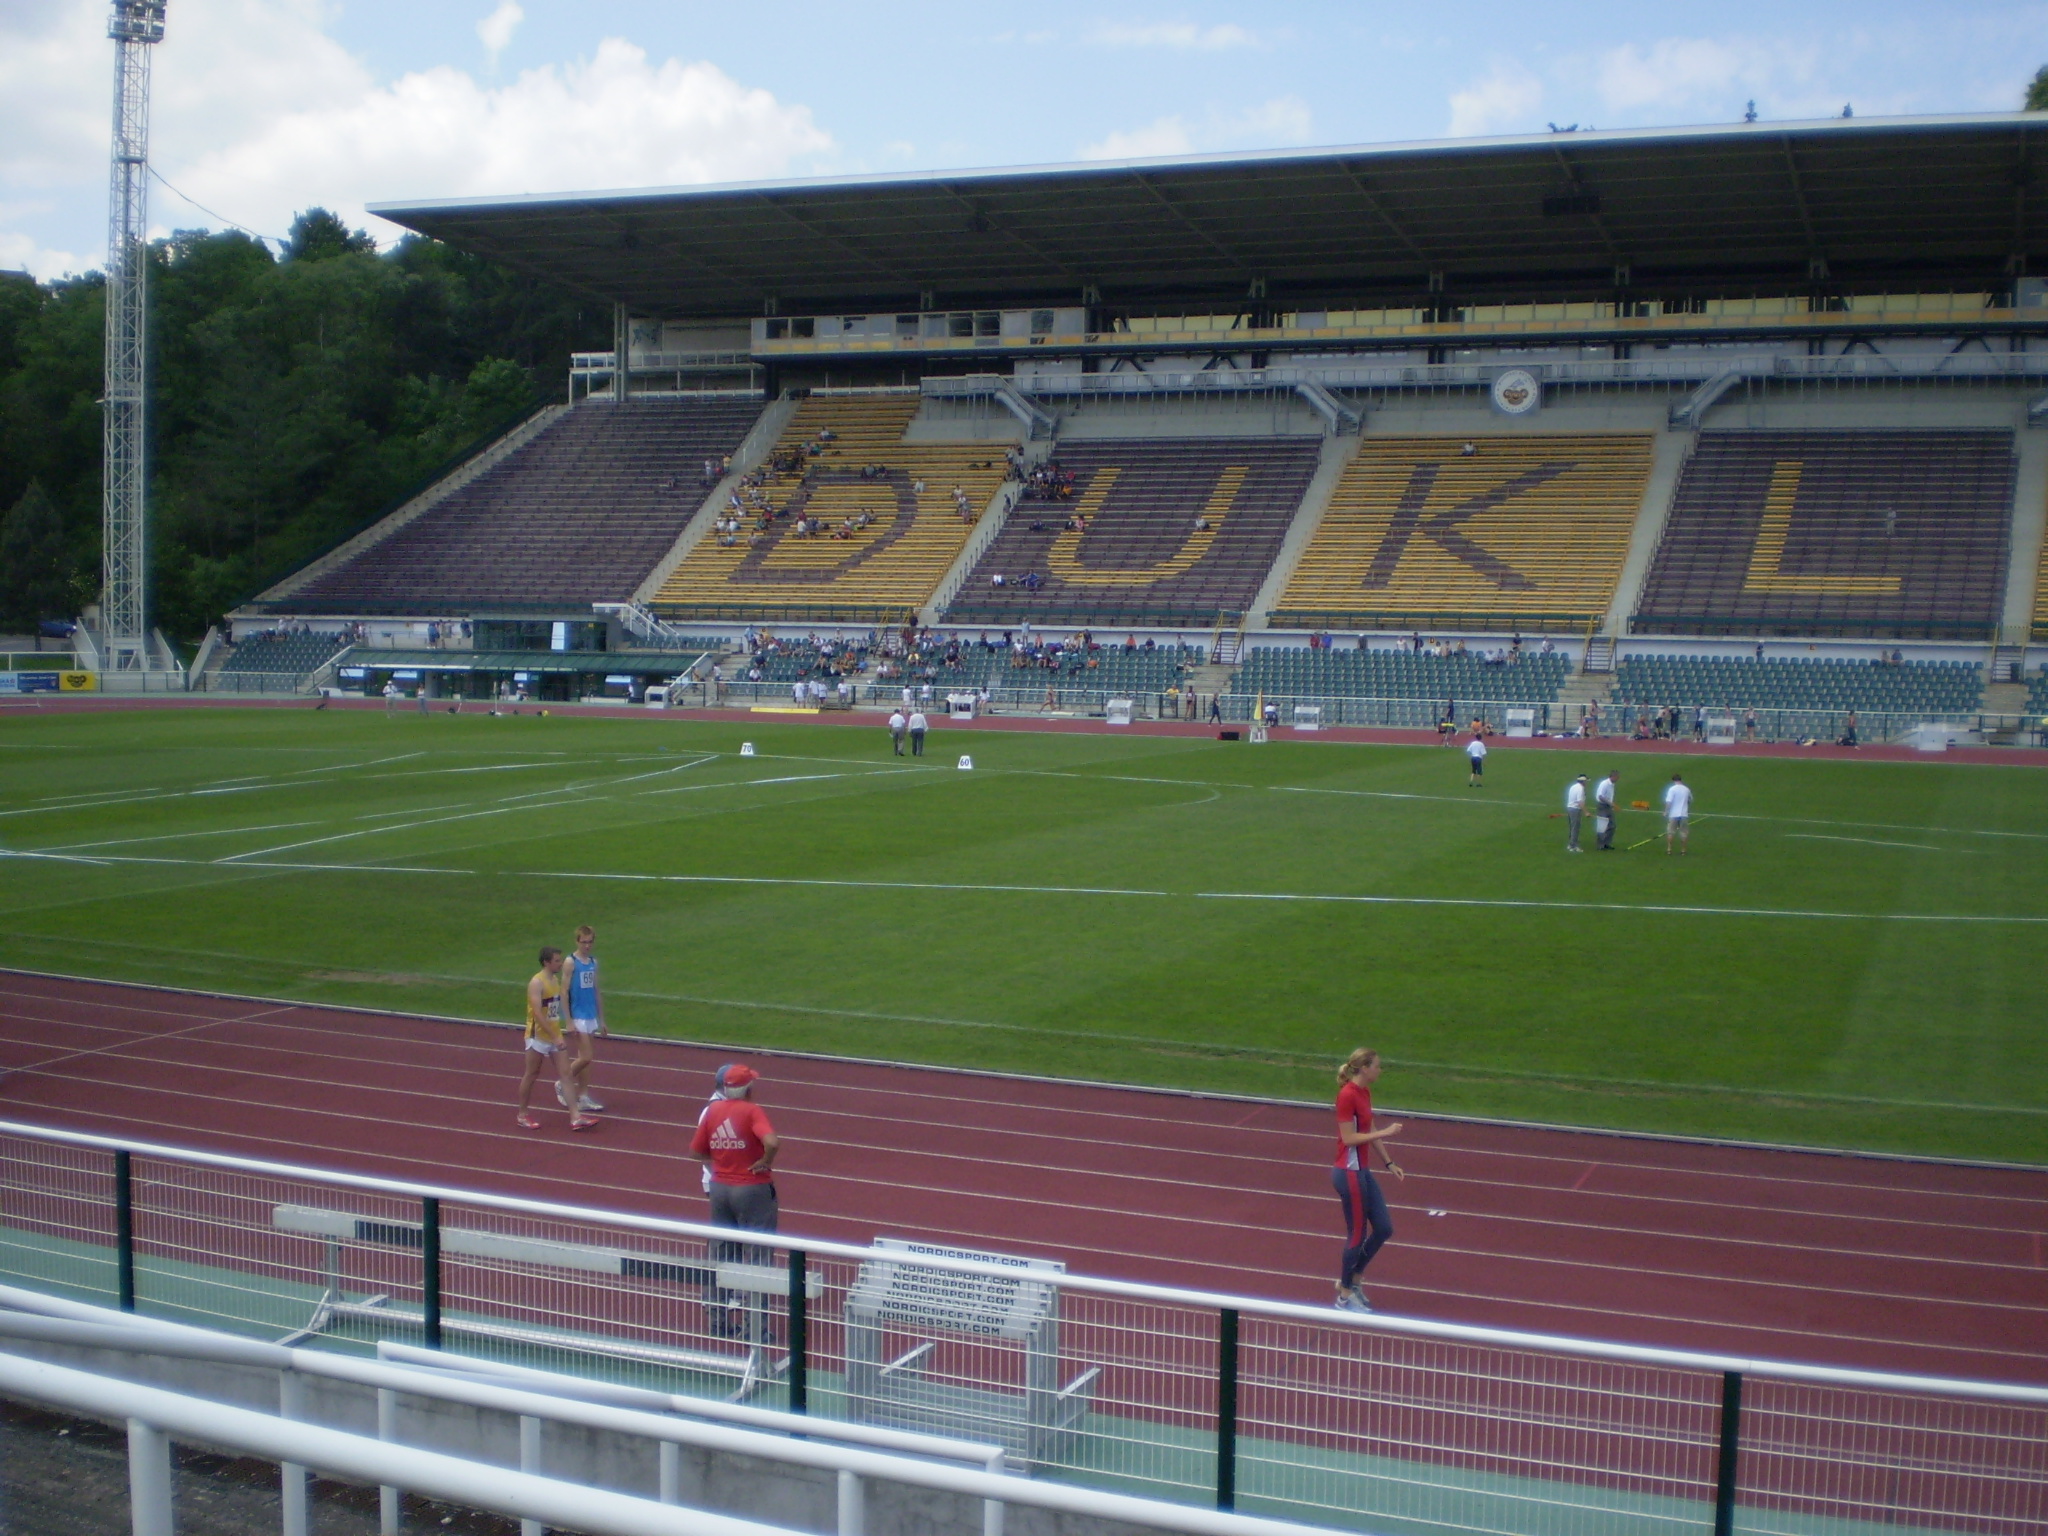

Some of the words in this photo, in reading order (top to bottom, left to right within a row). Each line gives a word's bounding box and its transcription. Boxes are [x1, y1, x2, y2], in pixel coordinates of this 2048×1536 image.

[742, 744, 752, 753] 70
[960, 758, 970, 767] 60
[709, 1137, 746, 1149] adidas
[908, 1244, 1030, 1269] NORDICSPORT.COM
[892, 1281, 1015, 1306] NORDICSPORT.COM
[893, 1272, 1015, 1297] NORDICSPORT.COM
[877, 1310, 1000, 1336] NORDICSPORT.COM
[882, 1300, 1005, 1326] NORDICSPORT.COM
